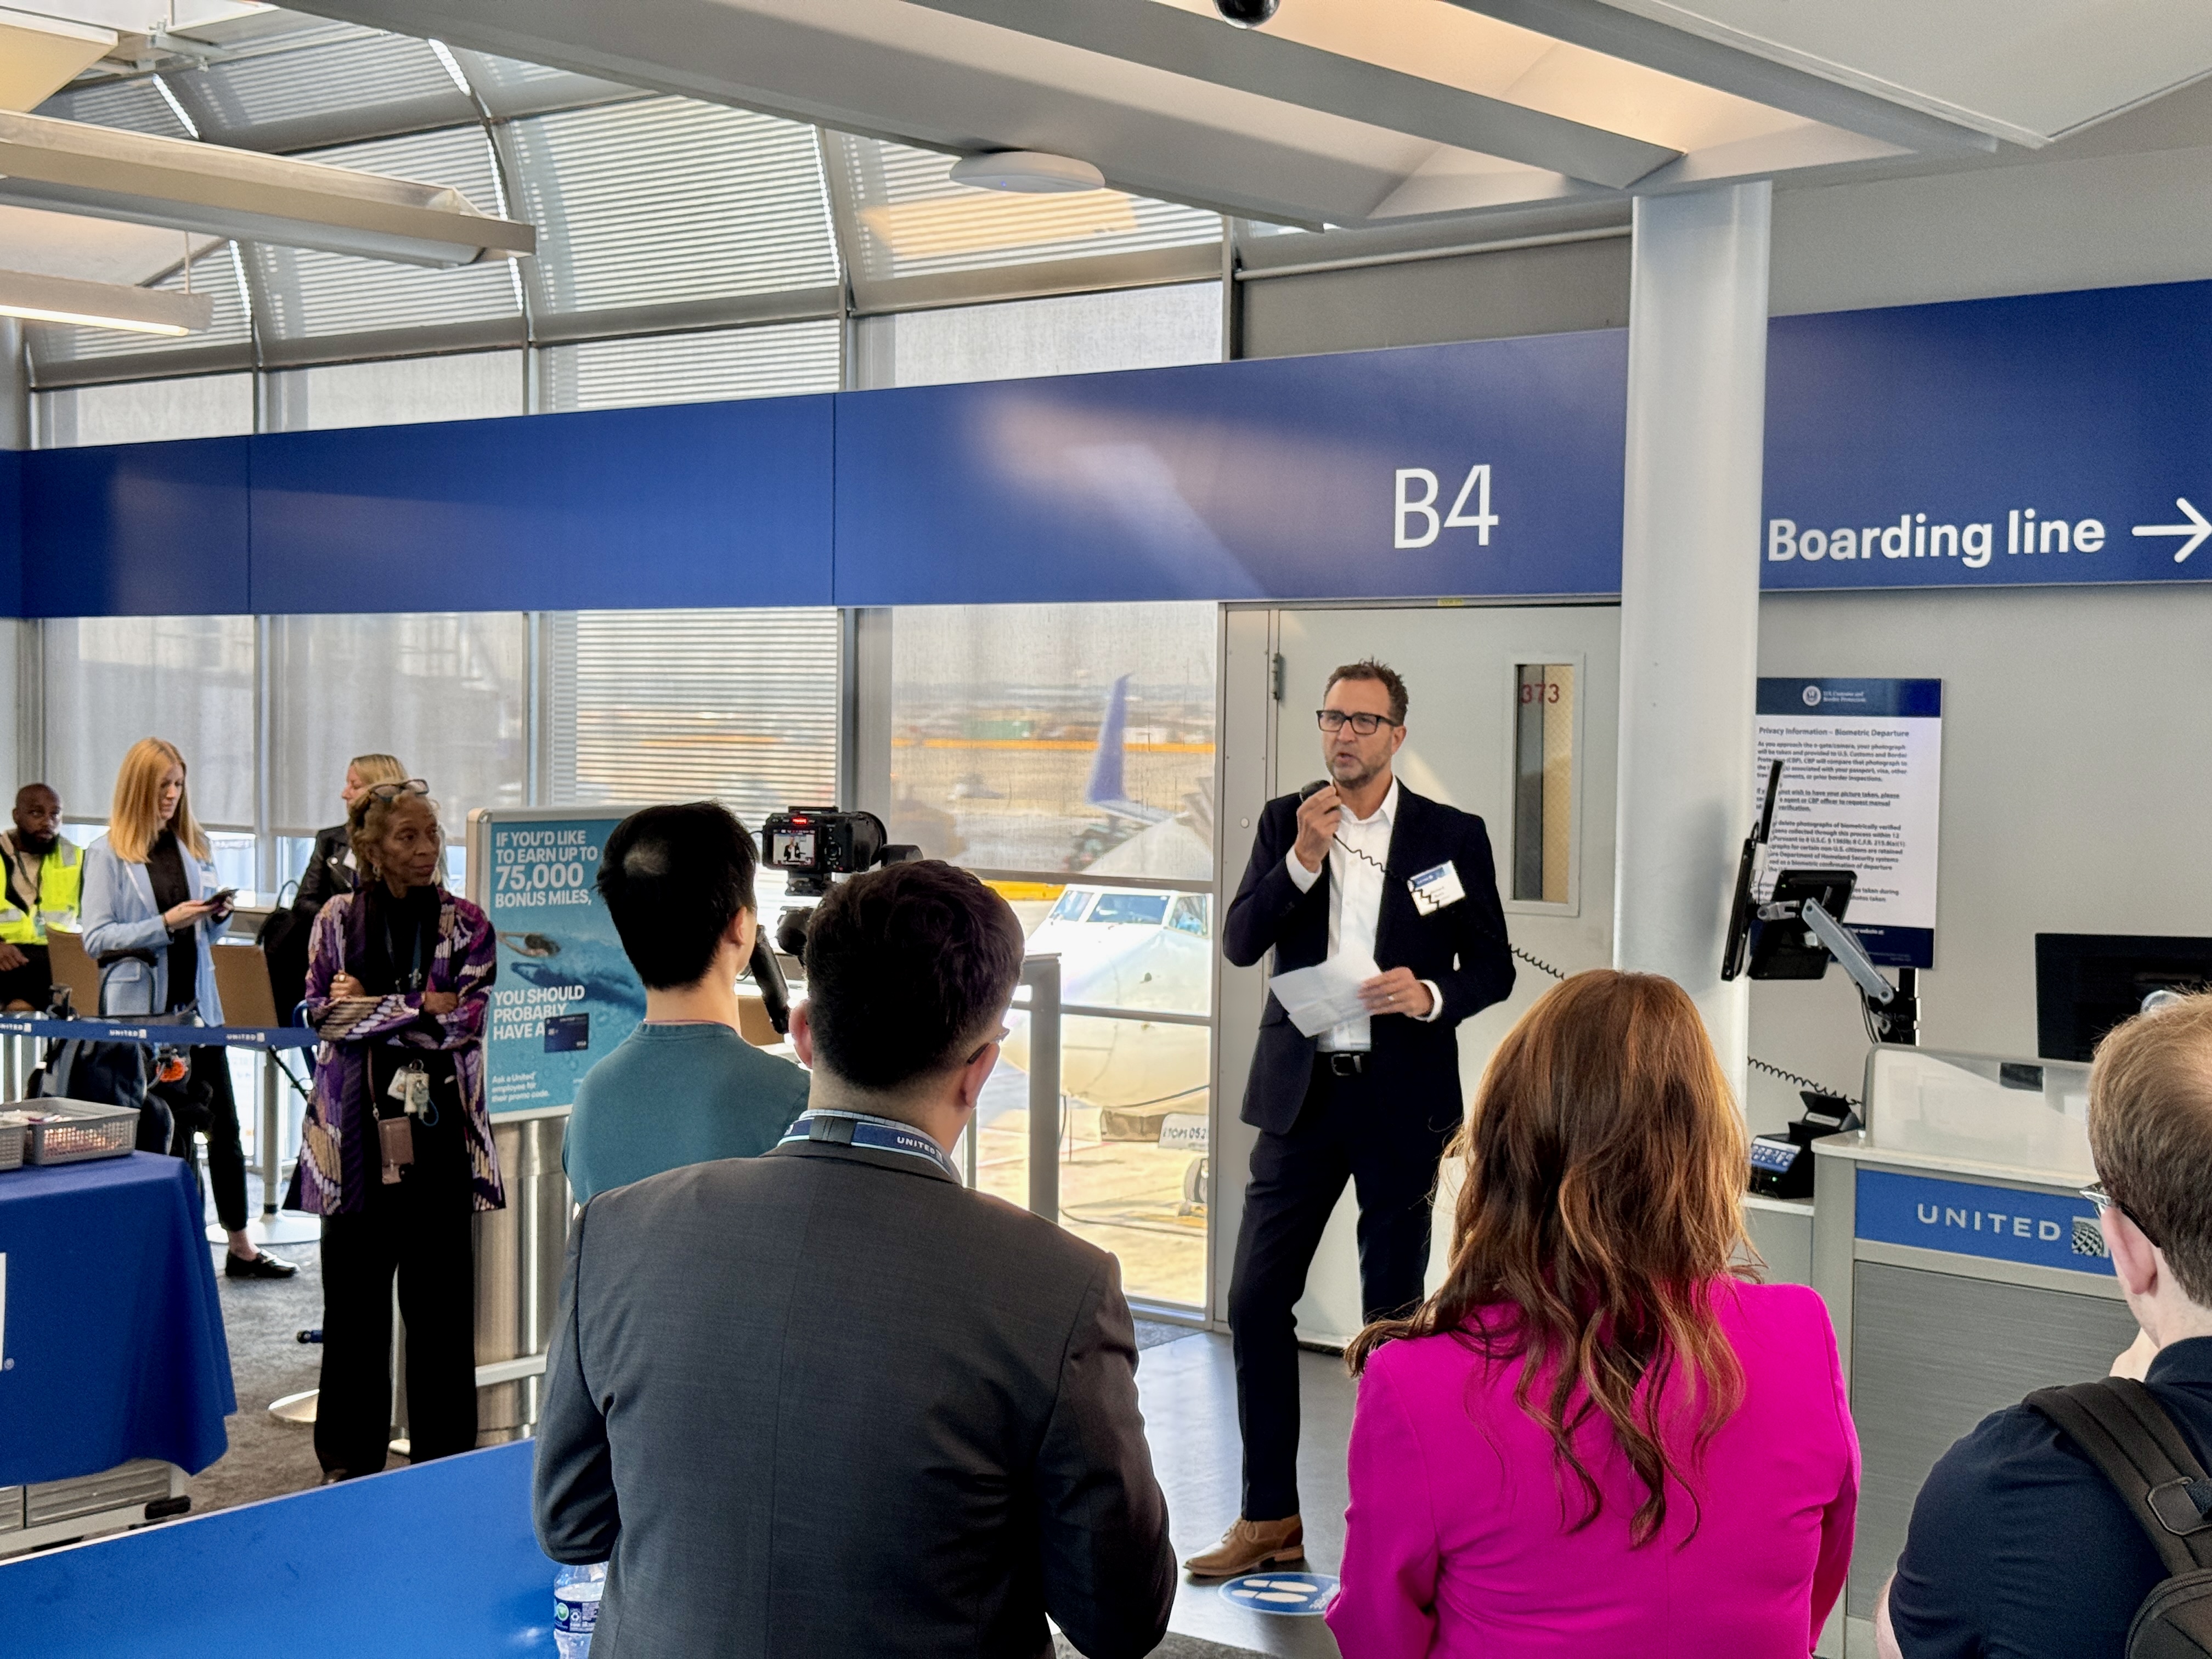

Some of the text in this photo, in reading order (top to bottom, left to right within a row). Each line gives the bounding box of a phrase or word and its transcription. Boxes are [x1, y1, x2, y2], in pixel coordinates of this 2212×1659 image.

[1395, 465, 1499, 549] B4
[1768, 508, 2106, 568] Boarding line
[1520, 684, 1559, 703] 373
[1759, 727, 1784, 736] Privacy
[1785, 727, 1828, 735] Information
[1871, 729, 1909, 737] Departure
[496, 830, 586, 847] IF YOU'D LIKE
[496, 846, 598, 864] TO EARN UP TO
[495, 862, 584, 891] 75,000
[495, 889, 592, 908] BONUS MILES,
[494, 985, 585, 1006] YOU SHOULD
[494, 1003, 568, 1024] PROBABLY
[494, 1022, 546, 1041] HAVE A
[897, 1136, 935, 1155] UNITED
[1917, 1203, 2061, 1241] UNITED
